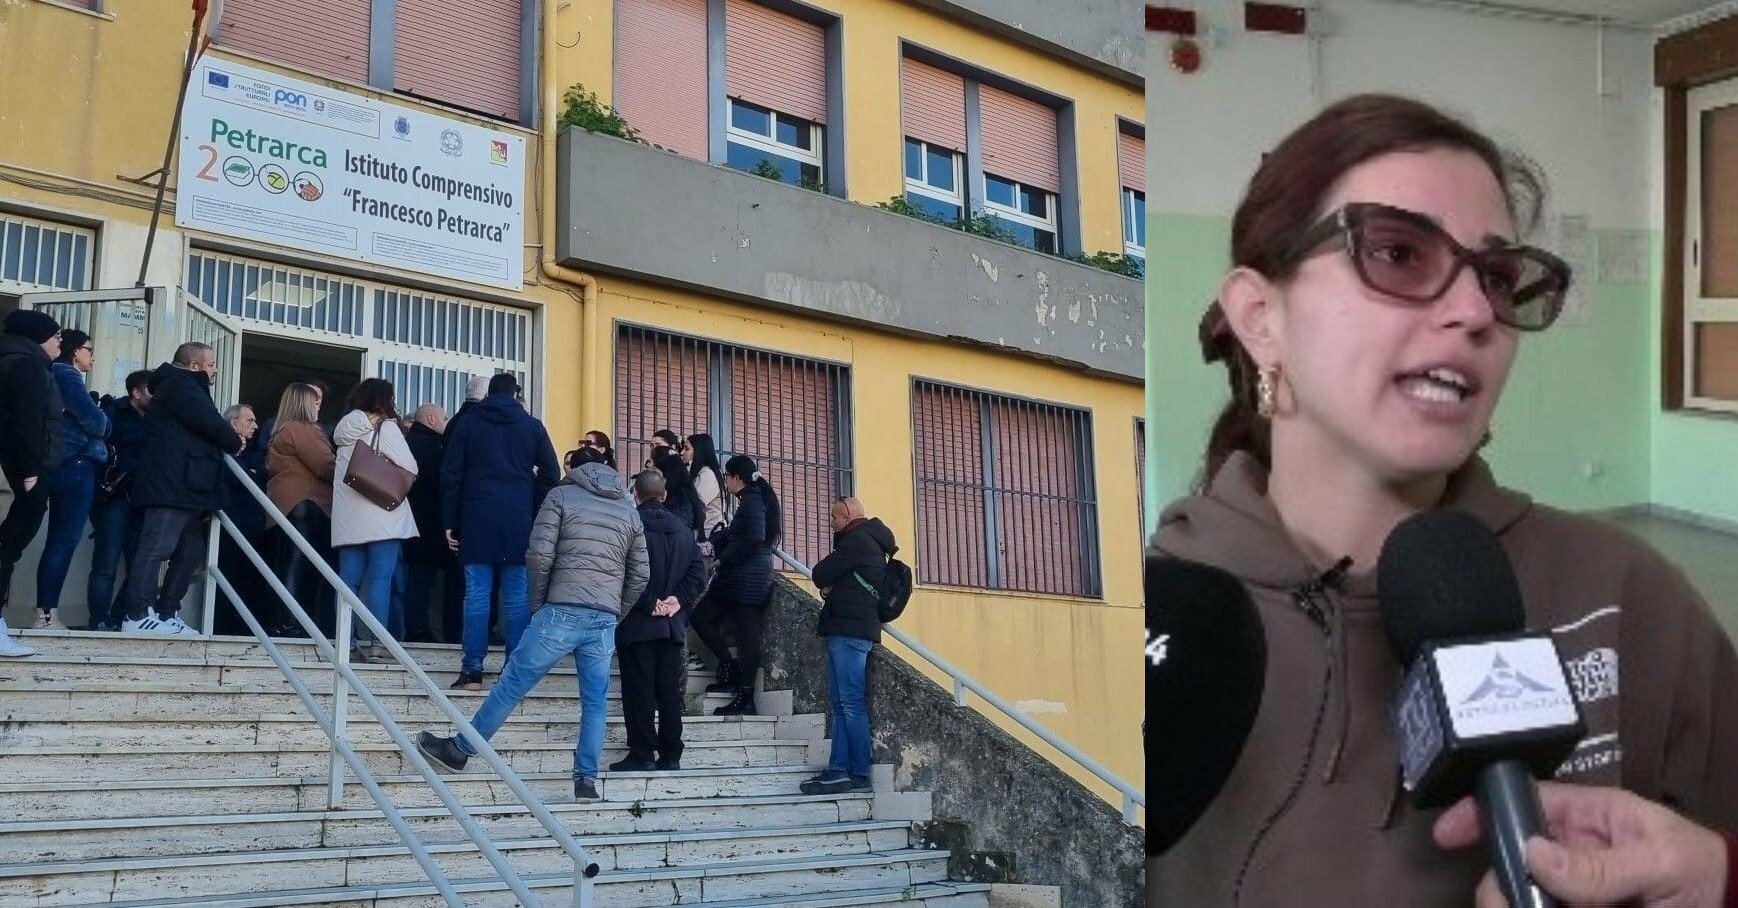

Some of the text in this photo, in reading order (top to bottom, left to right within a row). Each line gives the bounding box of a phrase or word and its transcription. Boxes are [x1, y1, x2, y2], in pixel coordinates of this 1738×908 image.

[274, 89, 307, 107] pon
[211, 118, 327, 168] Petrarca
[344, 149, 513, 209] Istituto Comprensivo
